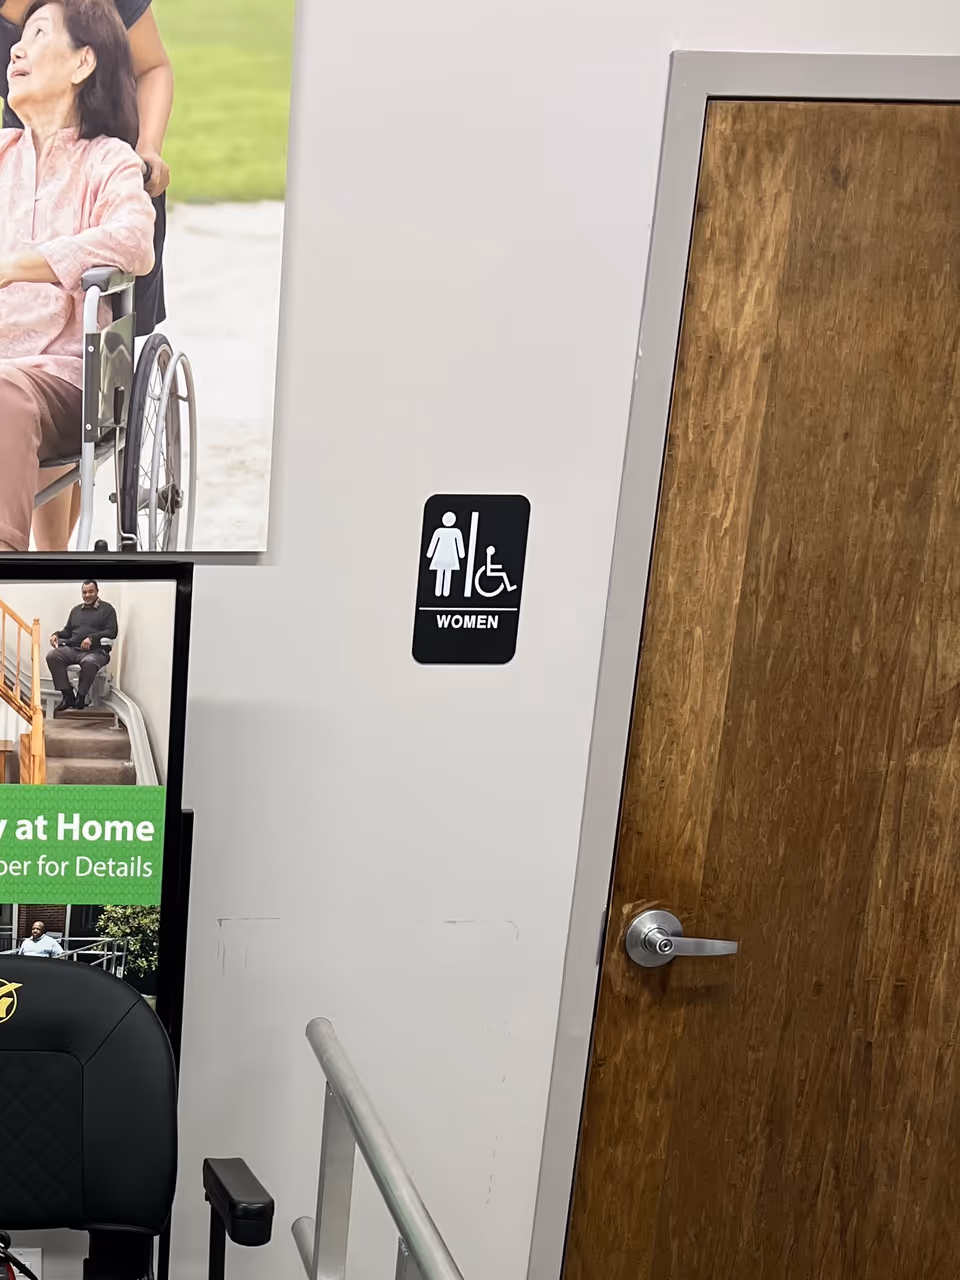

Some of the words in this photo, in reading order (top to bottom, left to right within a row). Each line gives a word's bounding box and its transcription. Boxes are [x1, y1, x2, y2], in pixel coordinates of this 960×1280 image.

[436, 614, 499, 629] WOMEN
[15, 814, 48, 841] at
[57, 812, 155, 842] Home
[37, 854, 70, 877] for
[75, 855, 153, 878] Details
